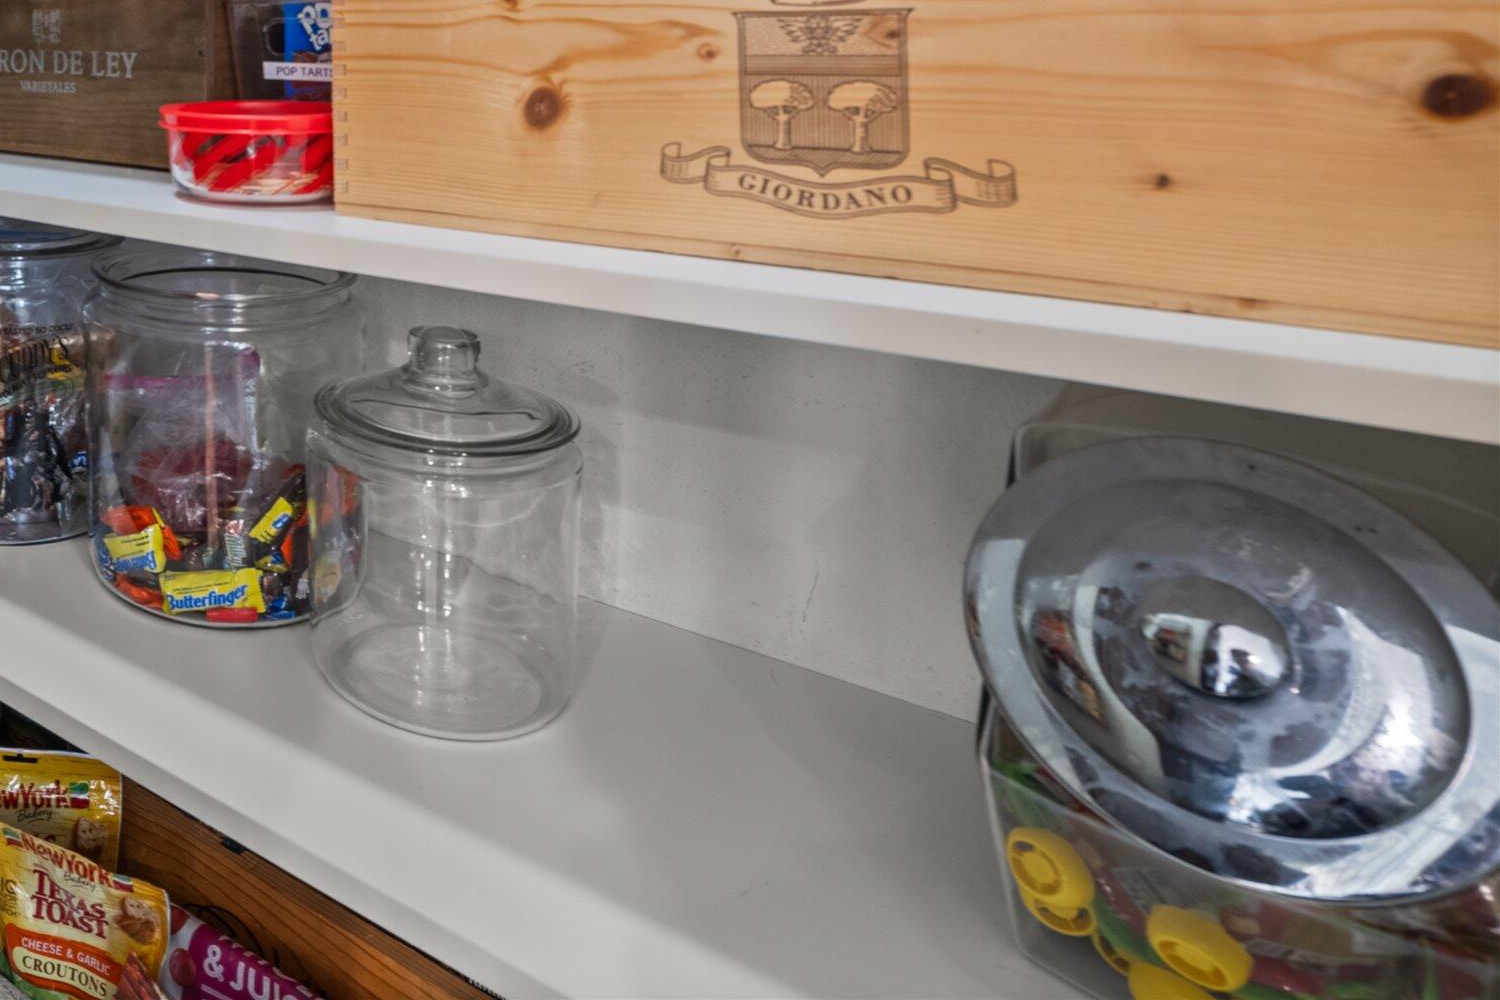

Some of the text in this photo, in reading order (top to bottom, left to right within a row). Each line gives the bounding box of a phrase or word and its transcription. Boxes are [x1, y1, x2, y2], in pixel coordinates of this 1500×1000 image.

[53, 50, 84, 76] DE
[91, 51, 139, 79] LEY
[275, 66, 297, 77] POP
[19, 80, 77, 94] VARIETALES
[737, 172, 915, 211] GIORDANO
[167, 584, 248, 611] Butterfinger
[32, 867, 106, 919] TEXAS
[31, 895, 109, 939] TOAST
[20, 937, 111, 977] CHEESE & GARLIC
[21, 955, 108, 997] CROUTONS
[203, 945, 225, 982] &
